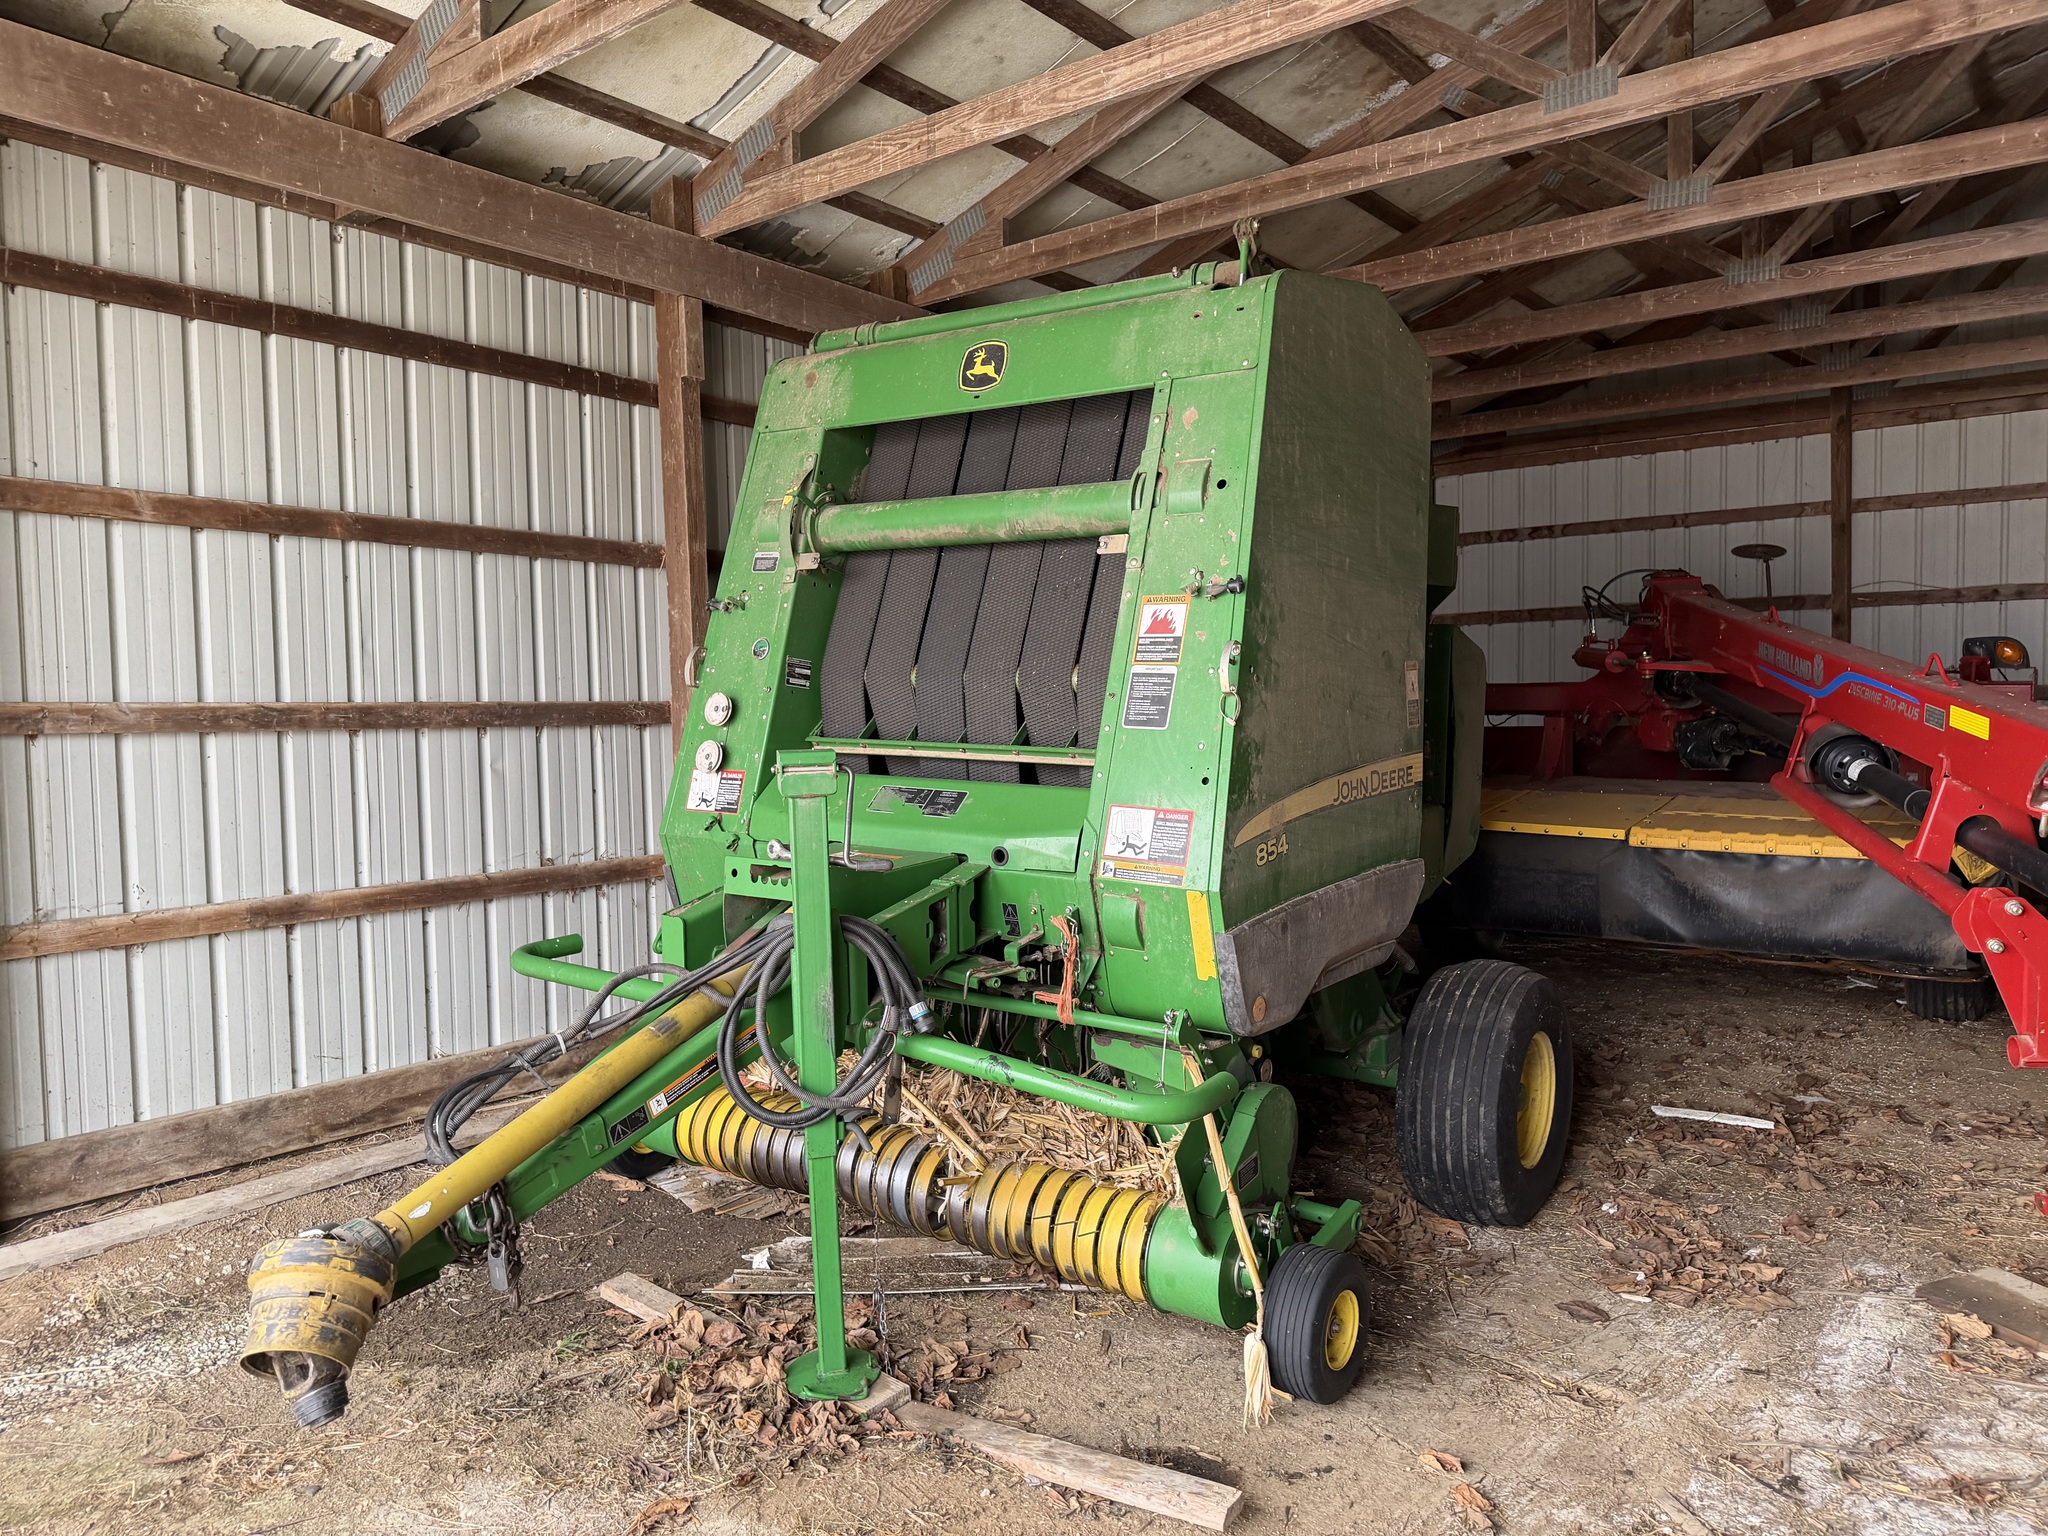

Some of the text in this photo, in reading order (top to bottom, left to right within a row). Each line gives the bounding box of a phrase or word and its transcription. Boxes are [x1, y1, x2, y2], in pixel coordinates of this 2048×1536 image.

[1758, 640, 1811, 682] NEW HOLLAND
[1848, 683, 1882, 705] DISCBINE
[1883, 696, 1897, 711] 310
[1333, 765, 1413, 803] JOHN DEERE
[1165, 813, 1189, 821] DANGER
[1256, 832, 1289, 867] 854
